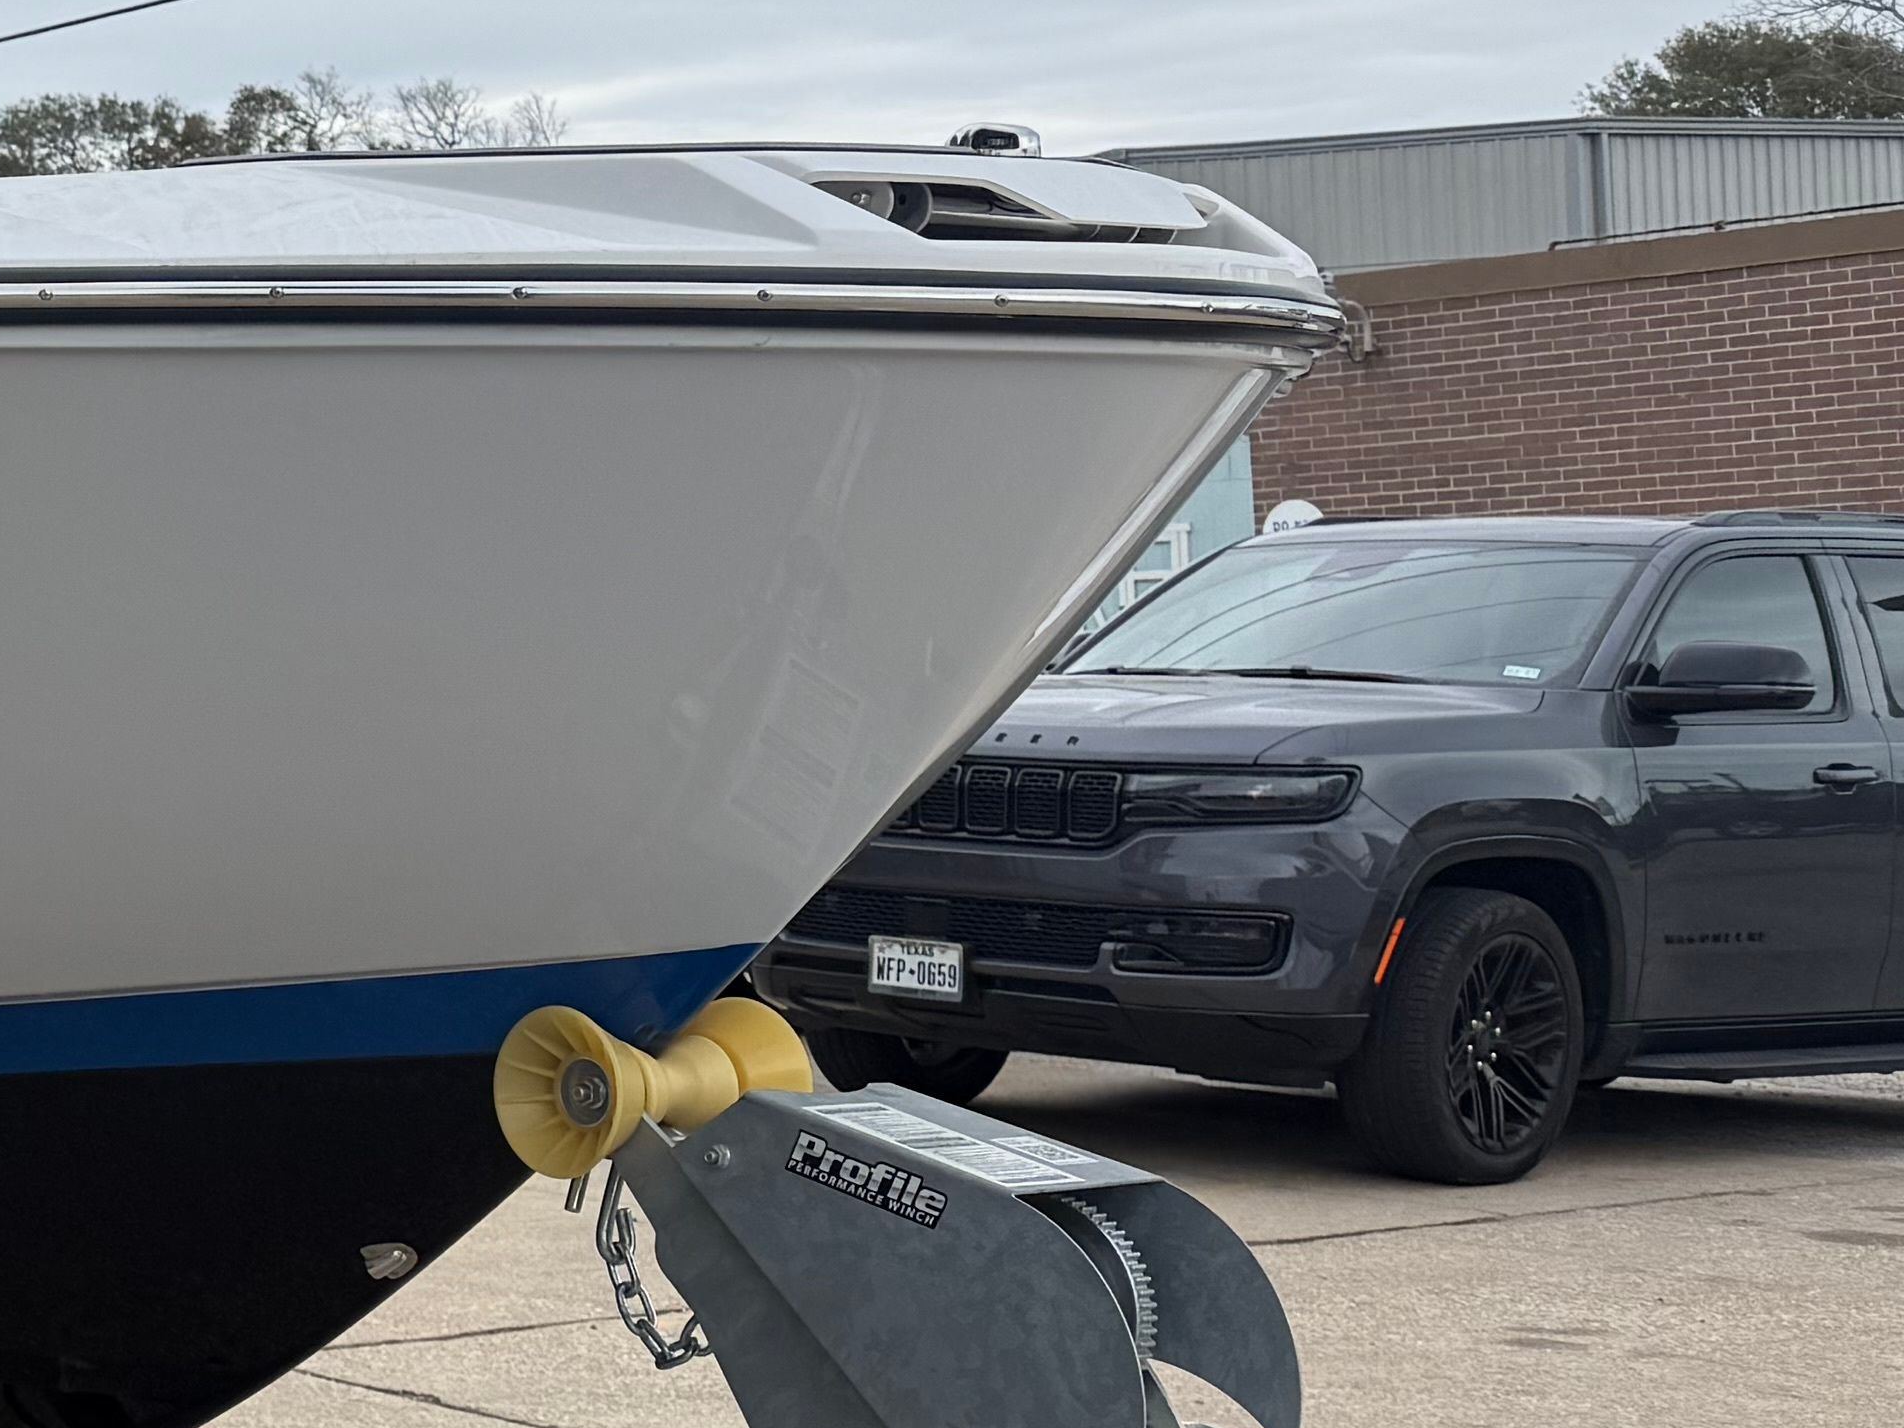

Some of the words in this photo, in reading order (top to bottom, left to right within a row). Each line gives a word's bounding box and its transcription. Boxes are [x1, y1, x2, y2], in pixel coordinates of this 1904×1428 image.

[787, 1159, 885, 1206] PERFORMANCE
[888, 1197, 936, 1226] WINCH
[791, 1130, 946, 1217] Profile
